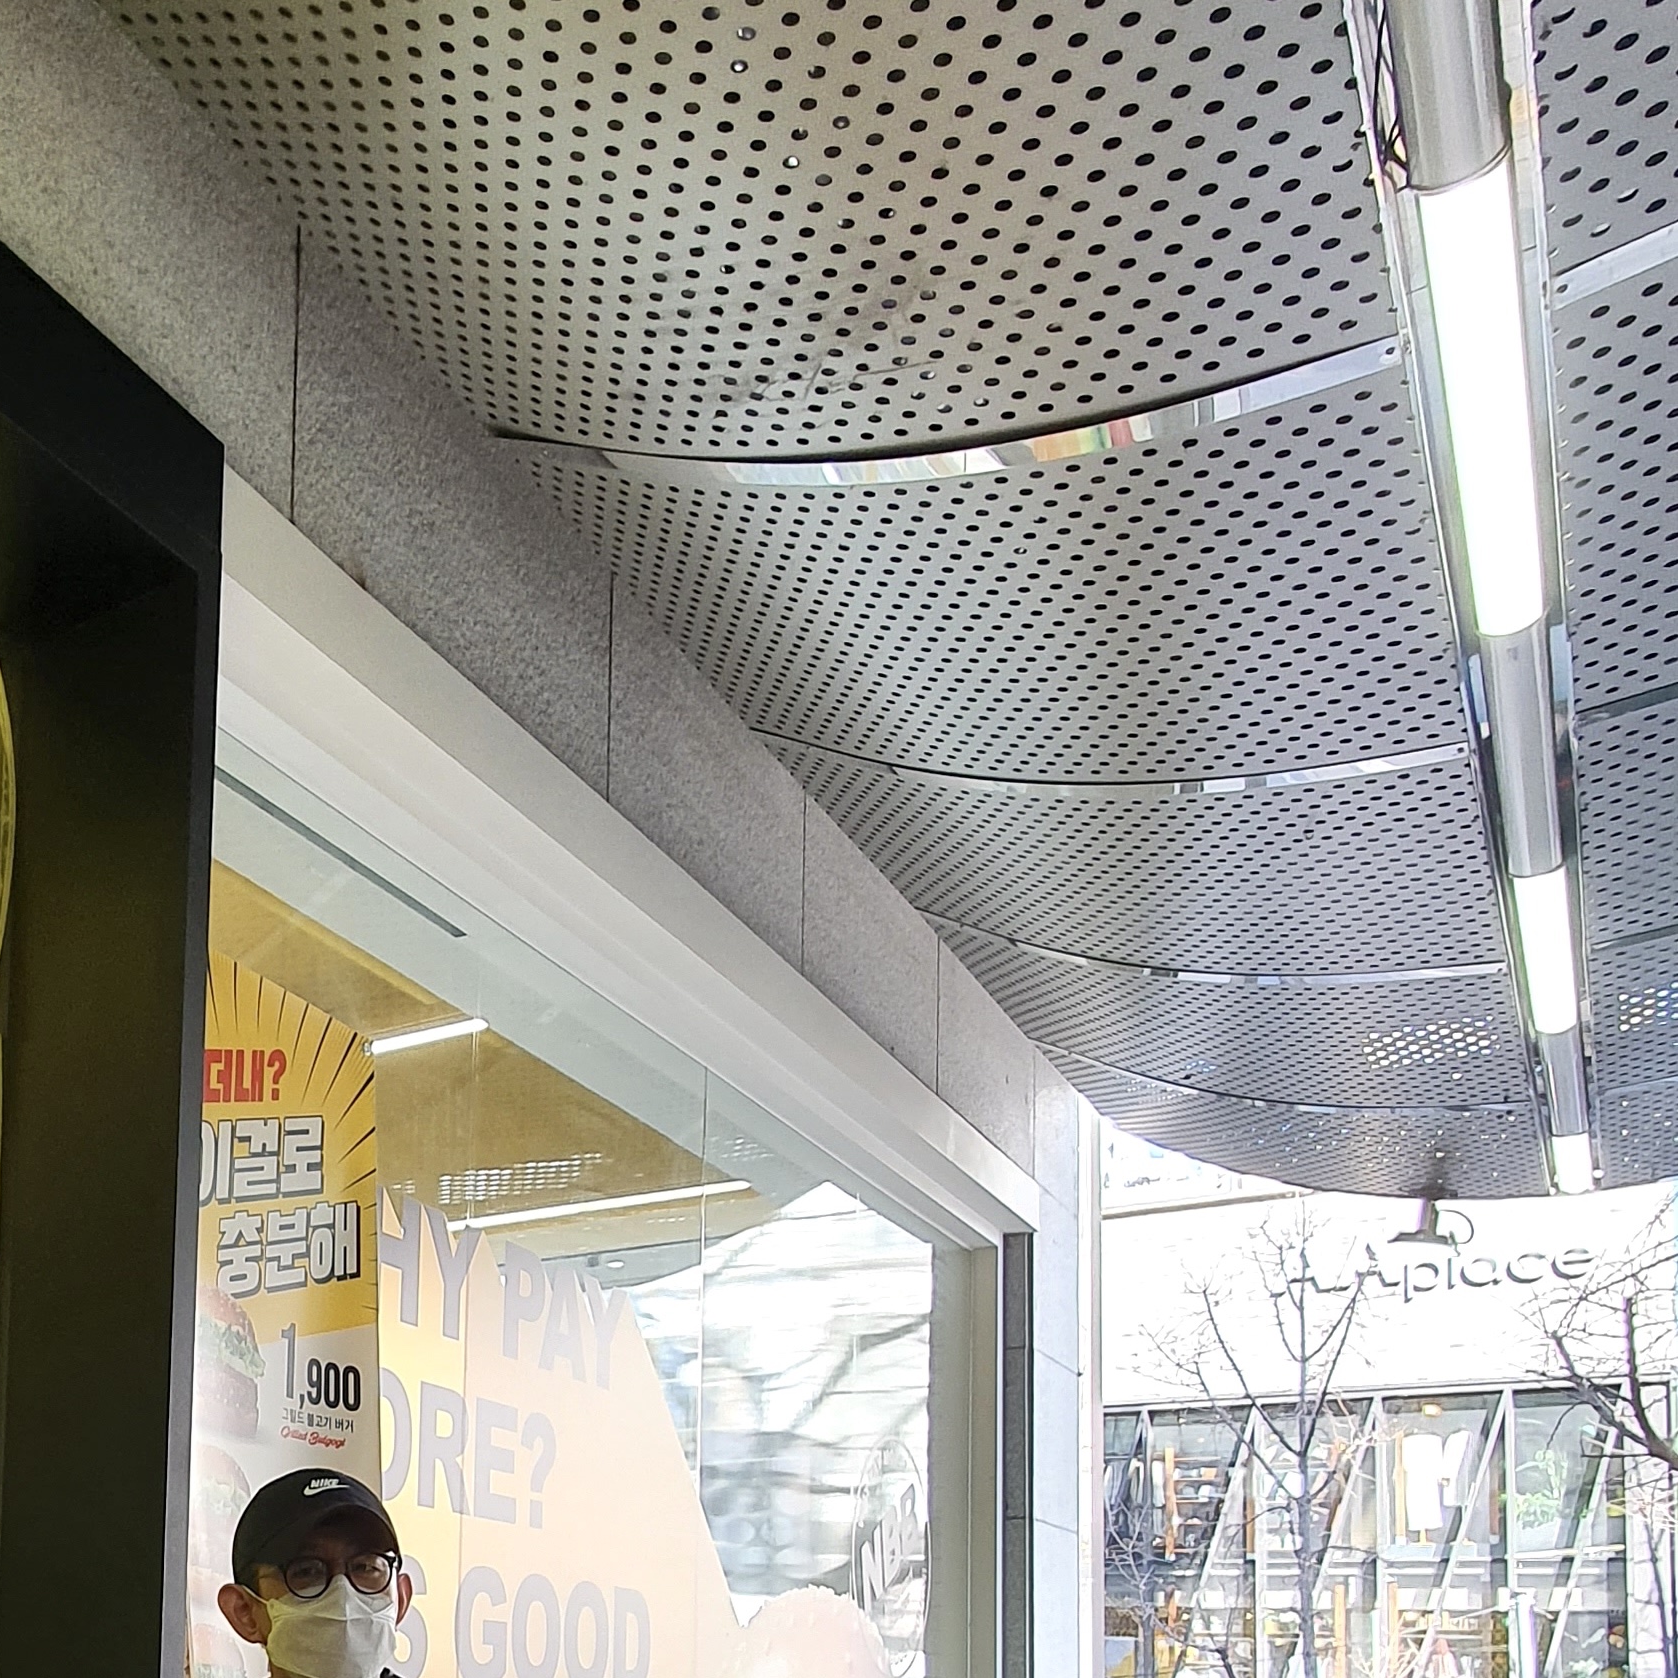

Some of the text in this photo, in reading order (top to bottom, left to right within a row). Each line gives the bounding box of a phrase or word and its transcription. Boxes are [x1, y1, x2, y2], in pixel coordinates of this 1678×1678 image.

[217, 1201, 361, 1299] 충분해
[503, 1241, 628, 1390] PAY
[282, 1323, 361, 1411] 1,900
[308, 1413, 332, 1430] 불고기
[335, 1418, 354, 1433] 버거
[310, 1478, 339, 1488] NIKE
